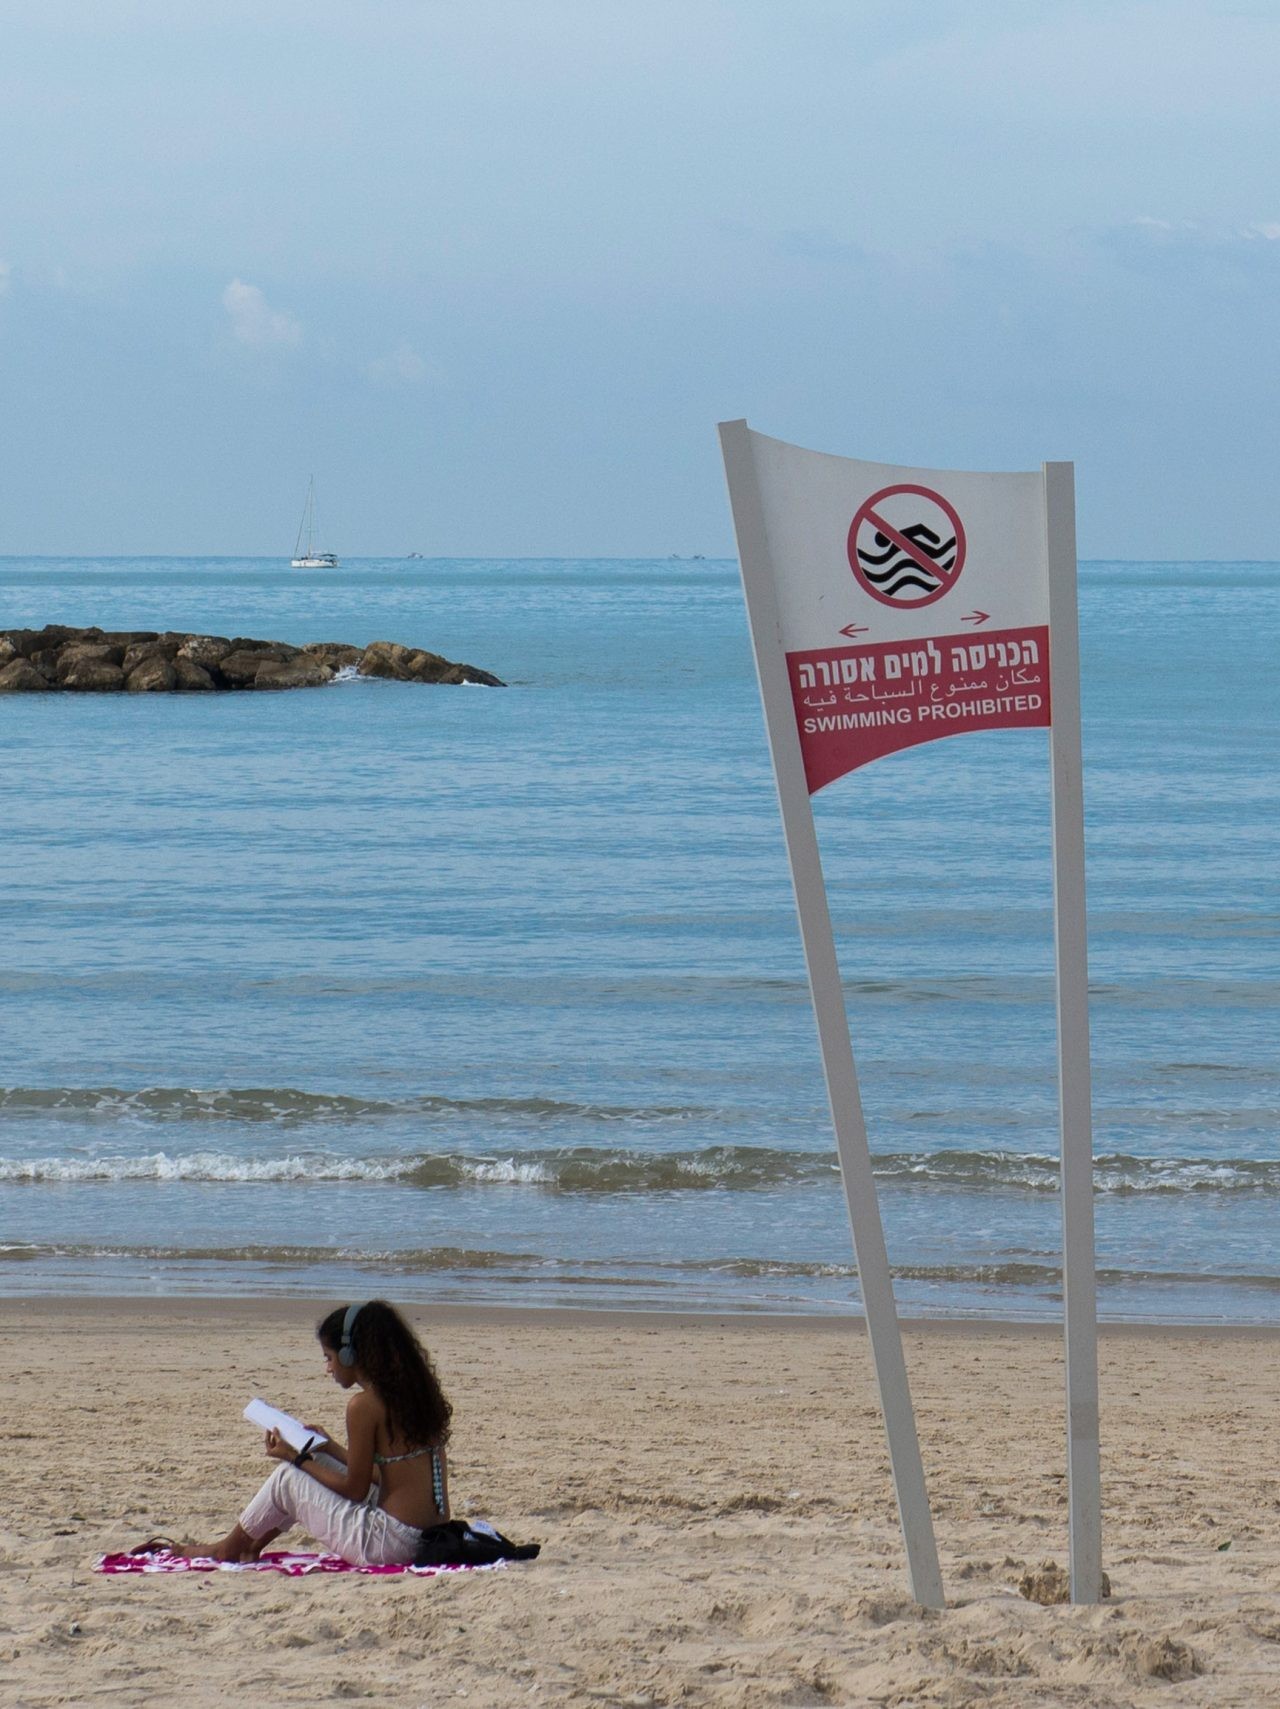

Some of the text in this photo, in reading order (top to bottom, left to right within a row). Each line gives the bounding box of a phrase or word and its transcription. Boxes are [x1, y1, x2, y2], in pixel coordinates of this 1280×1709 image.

[798, 639, 1039, 689] הכניסה למים אסורה
[844, 679, 923, 705] السباحة
[995, 668, 1041, 692] مكان
[803, 690, 837, 712] فيه
[804, 694, 1042, 733] SWIMMING PROHIBITED
